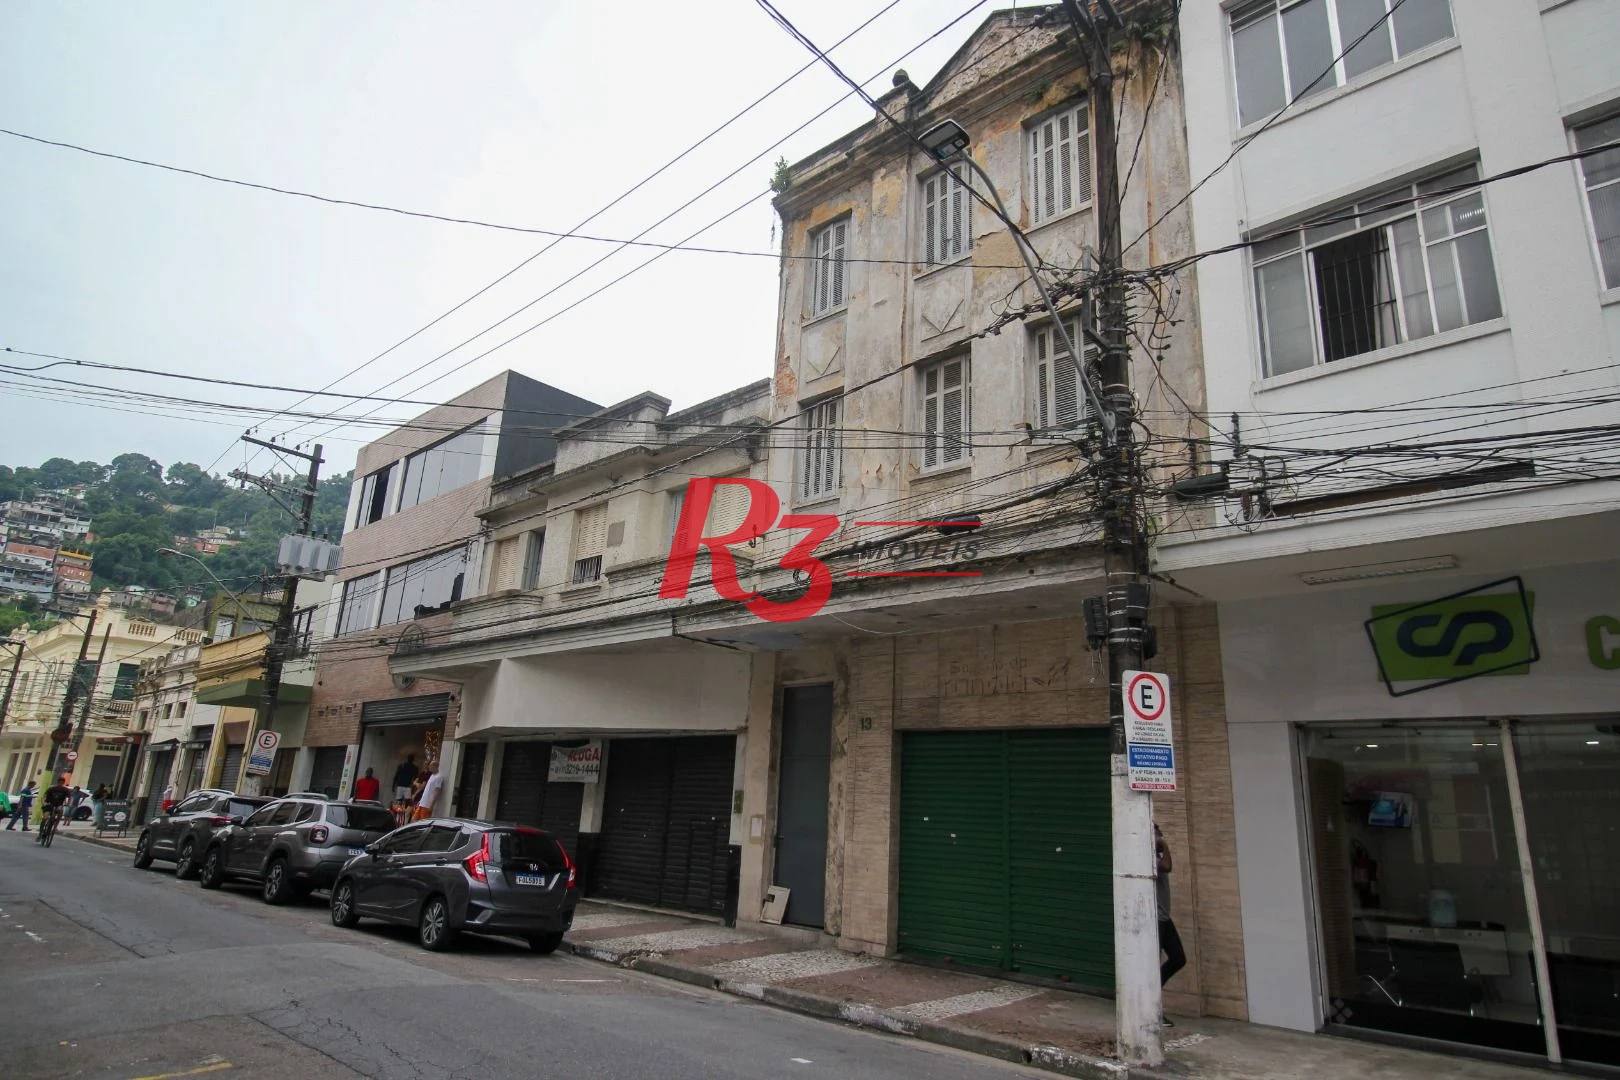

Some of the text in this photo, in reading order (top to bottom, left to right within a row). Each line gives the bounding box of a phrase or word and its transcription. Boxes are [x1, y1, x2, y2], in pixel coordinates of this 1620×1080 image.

[1141, 684, 1154, 709] E
[859, 717, 872, 731] 13
[263, 735, 273, 746] E
